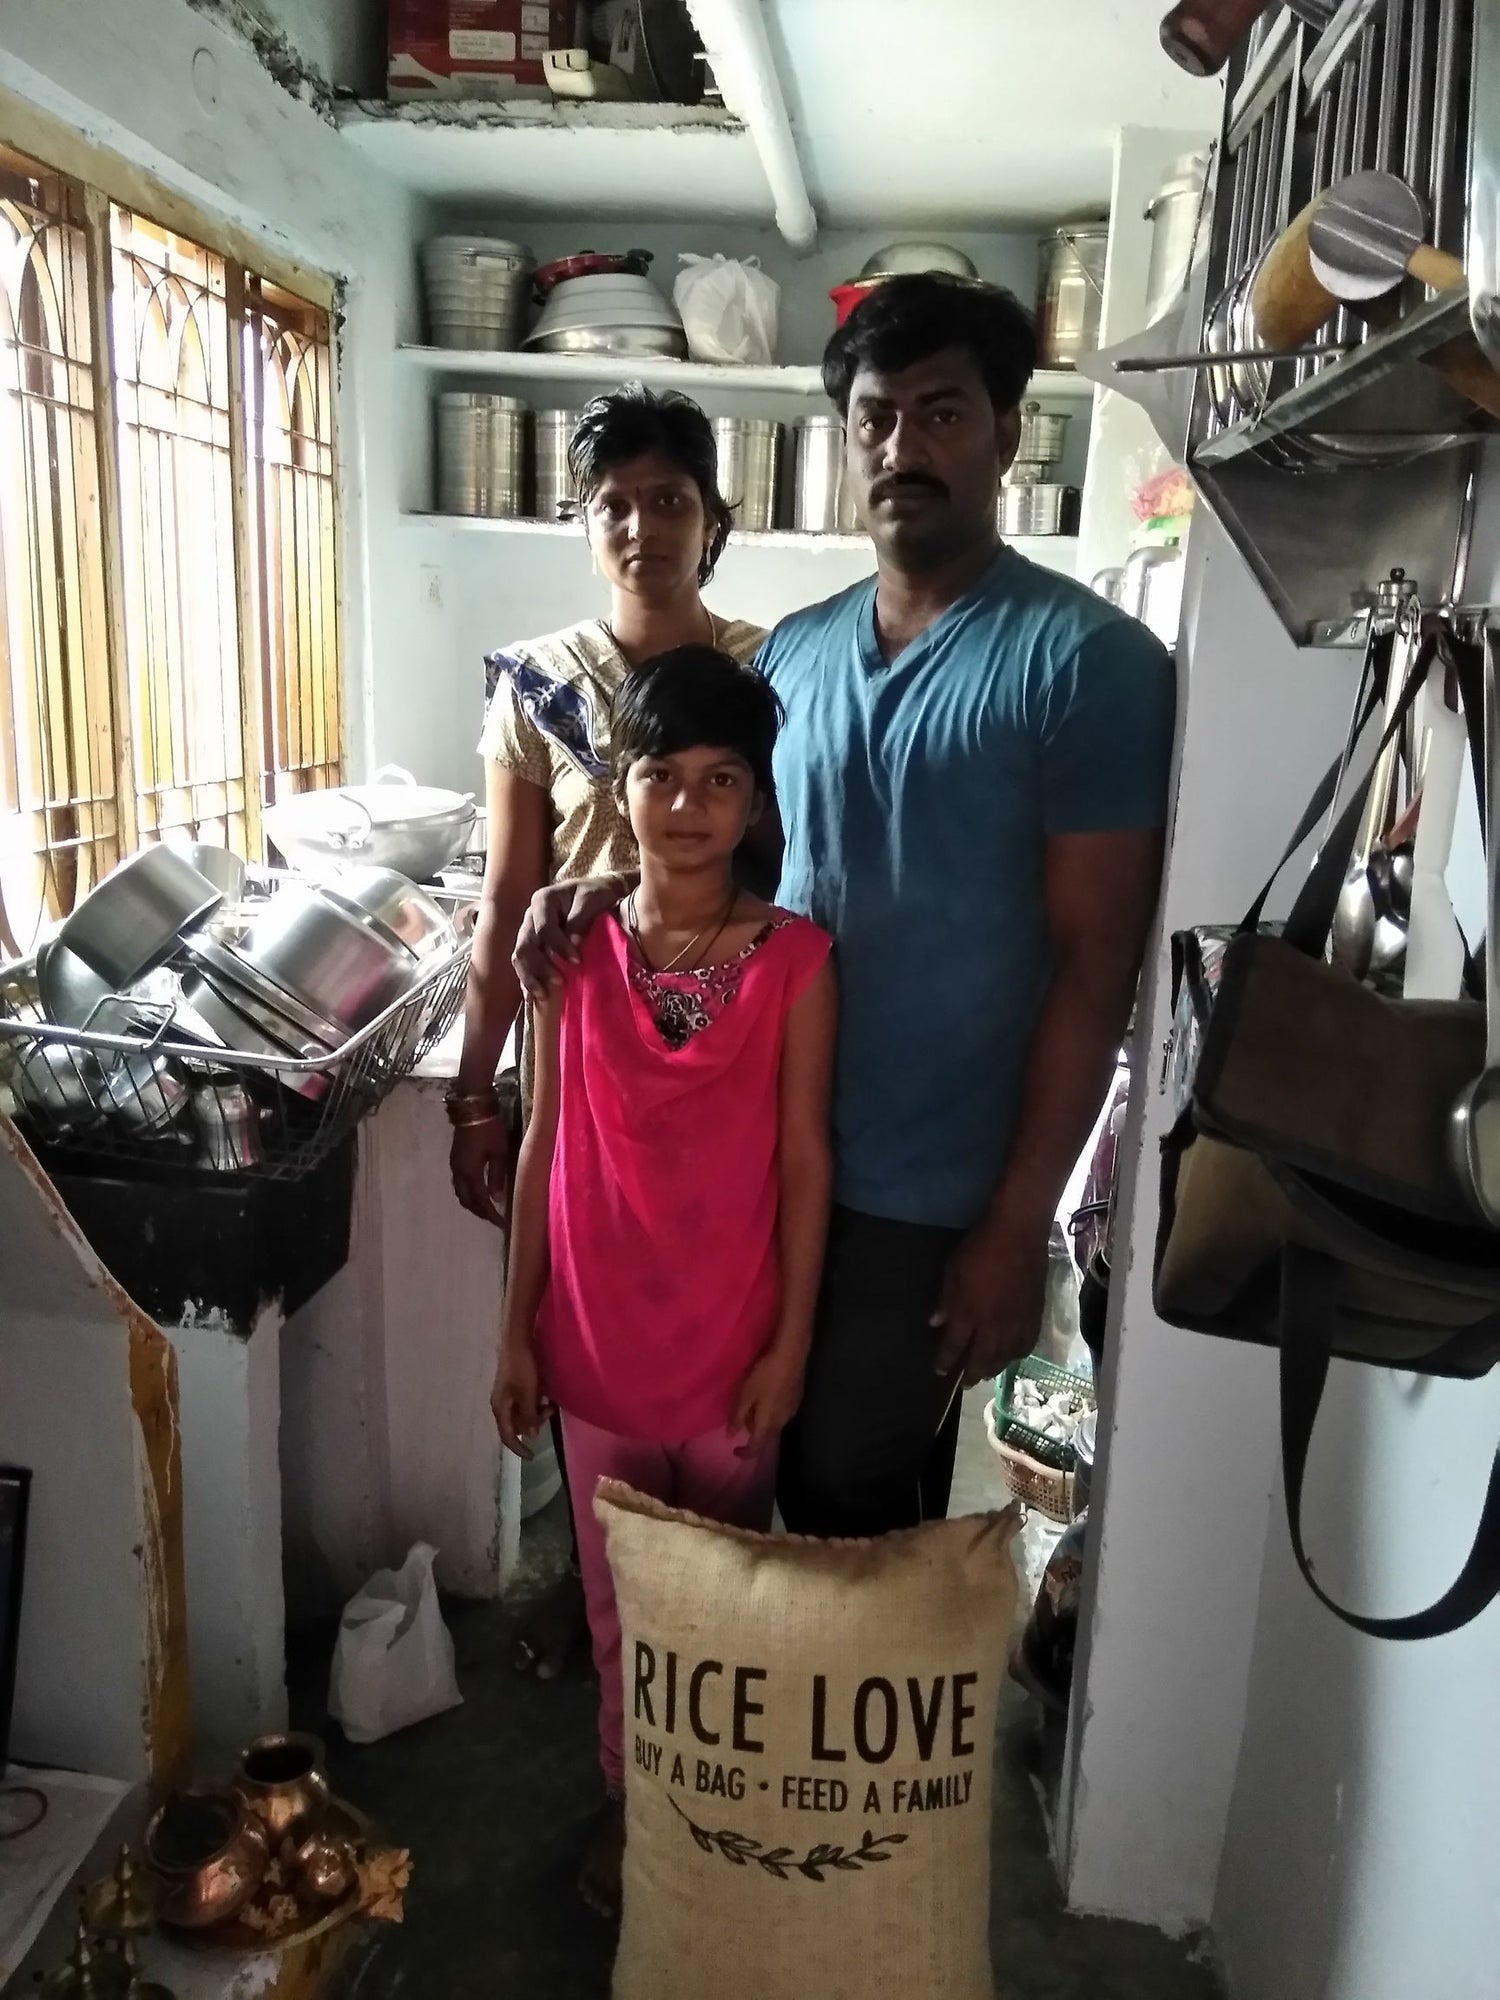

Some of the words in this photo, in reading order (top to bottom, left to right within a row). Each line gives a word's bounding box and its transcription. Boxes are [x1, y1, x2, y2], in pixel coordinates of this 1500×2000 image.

[634, 1640, 768, 1755] RICE
[811, 1671, 978, 1764] LOVE
[635, 1734, 662, 1777] BUY
[670, 1752, 686, 1787] A
[695, 1759, 746, 1801] BAG
[781, 1775, 849, 1813] FEED
[863, 1780, 881, 1814] A
[893, 1770, 974, 1814] FAMILY
